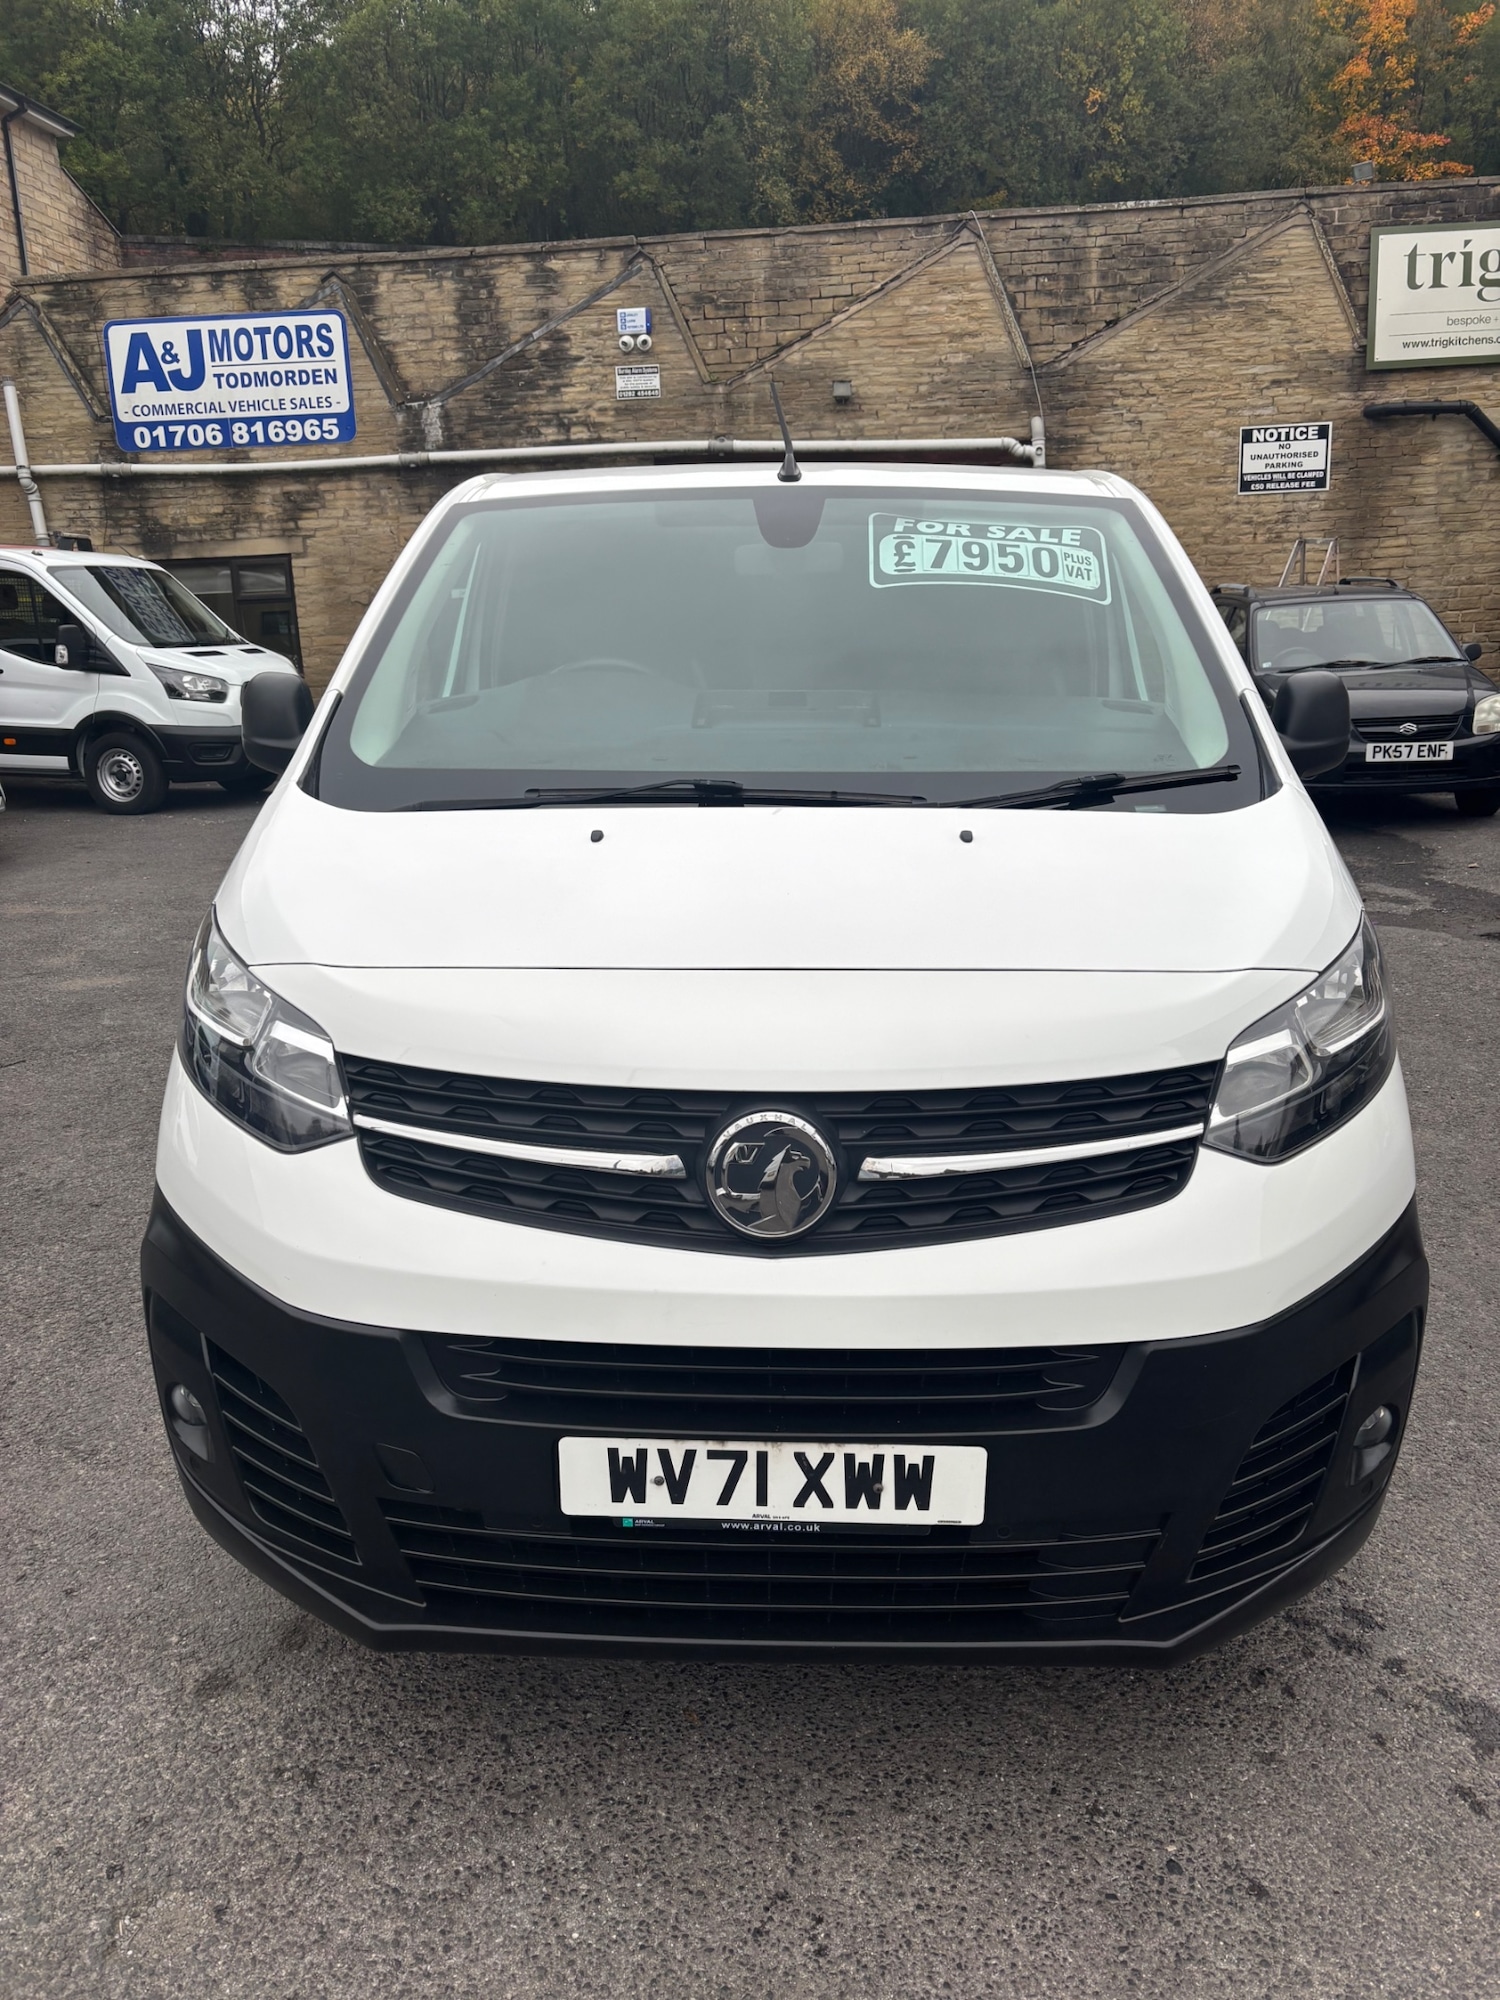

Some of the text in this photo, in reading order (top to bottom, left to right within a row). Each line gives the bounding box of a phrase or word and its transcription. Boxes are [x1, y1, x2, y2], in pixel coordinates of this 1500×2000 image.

[1446, 315, 1491, 326] bespoke
[121, 323, 335, 394] A&J MOTORS
[213, 368, 338, 389] TODMORDEN
[132, 401, 226, 417] COMMERCIAL
[228, 398, 286, 413] VEHICLE
[291, 396, 332, 410] SALES
[133, 418, 339, 449] 01706 816965
[1252, 426, 1319, 442] NOTICE
[1250, 451, 1319, 460] UNAUTHORISED
[1265, 461, 1303, 469] PARKING
[1243, 473, 1271, 481] VEHICLES
[1296, 471, 1324, 479] CLAMPED
[893, 517, 1082, 546] FOR SALE
[893, 535, 1060, 579] £7950
[1063, 552, 1092, 566] PLUS
[1065, 564, 1092, 581] VAT
[1372, 744, 1447, 759] PK57 ENF
[723, 1114, 817, 1139] VAUXHALL
[607, 1447, 936, 1511] WV71 XWW
[721, 1521, 820, 1532] www.arval.co.uk
